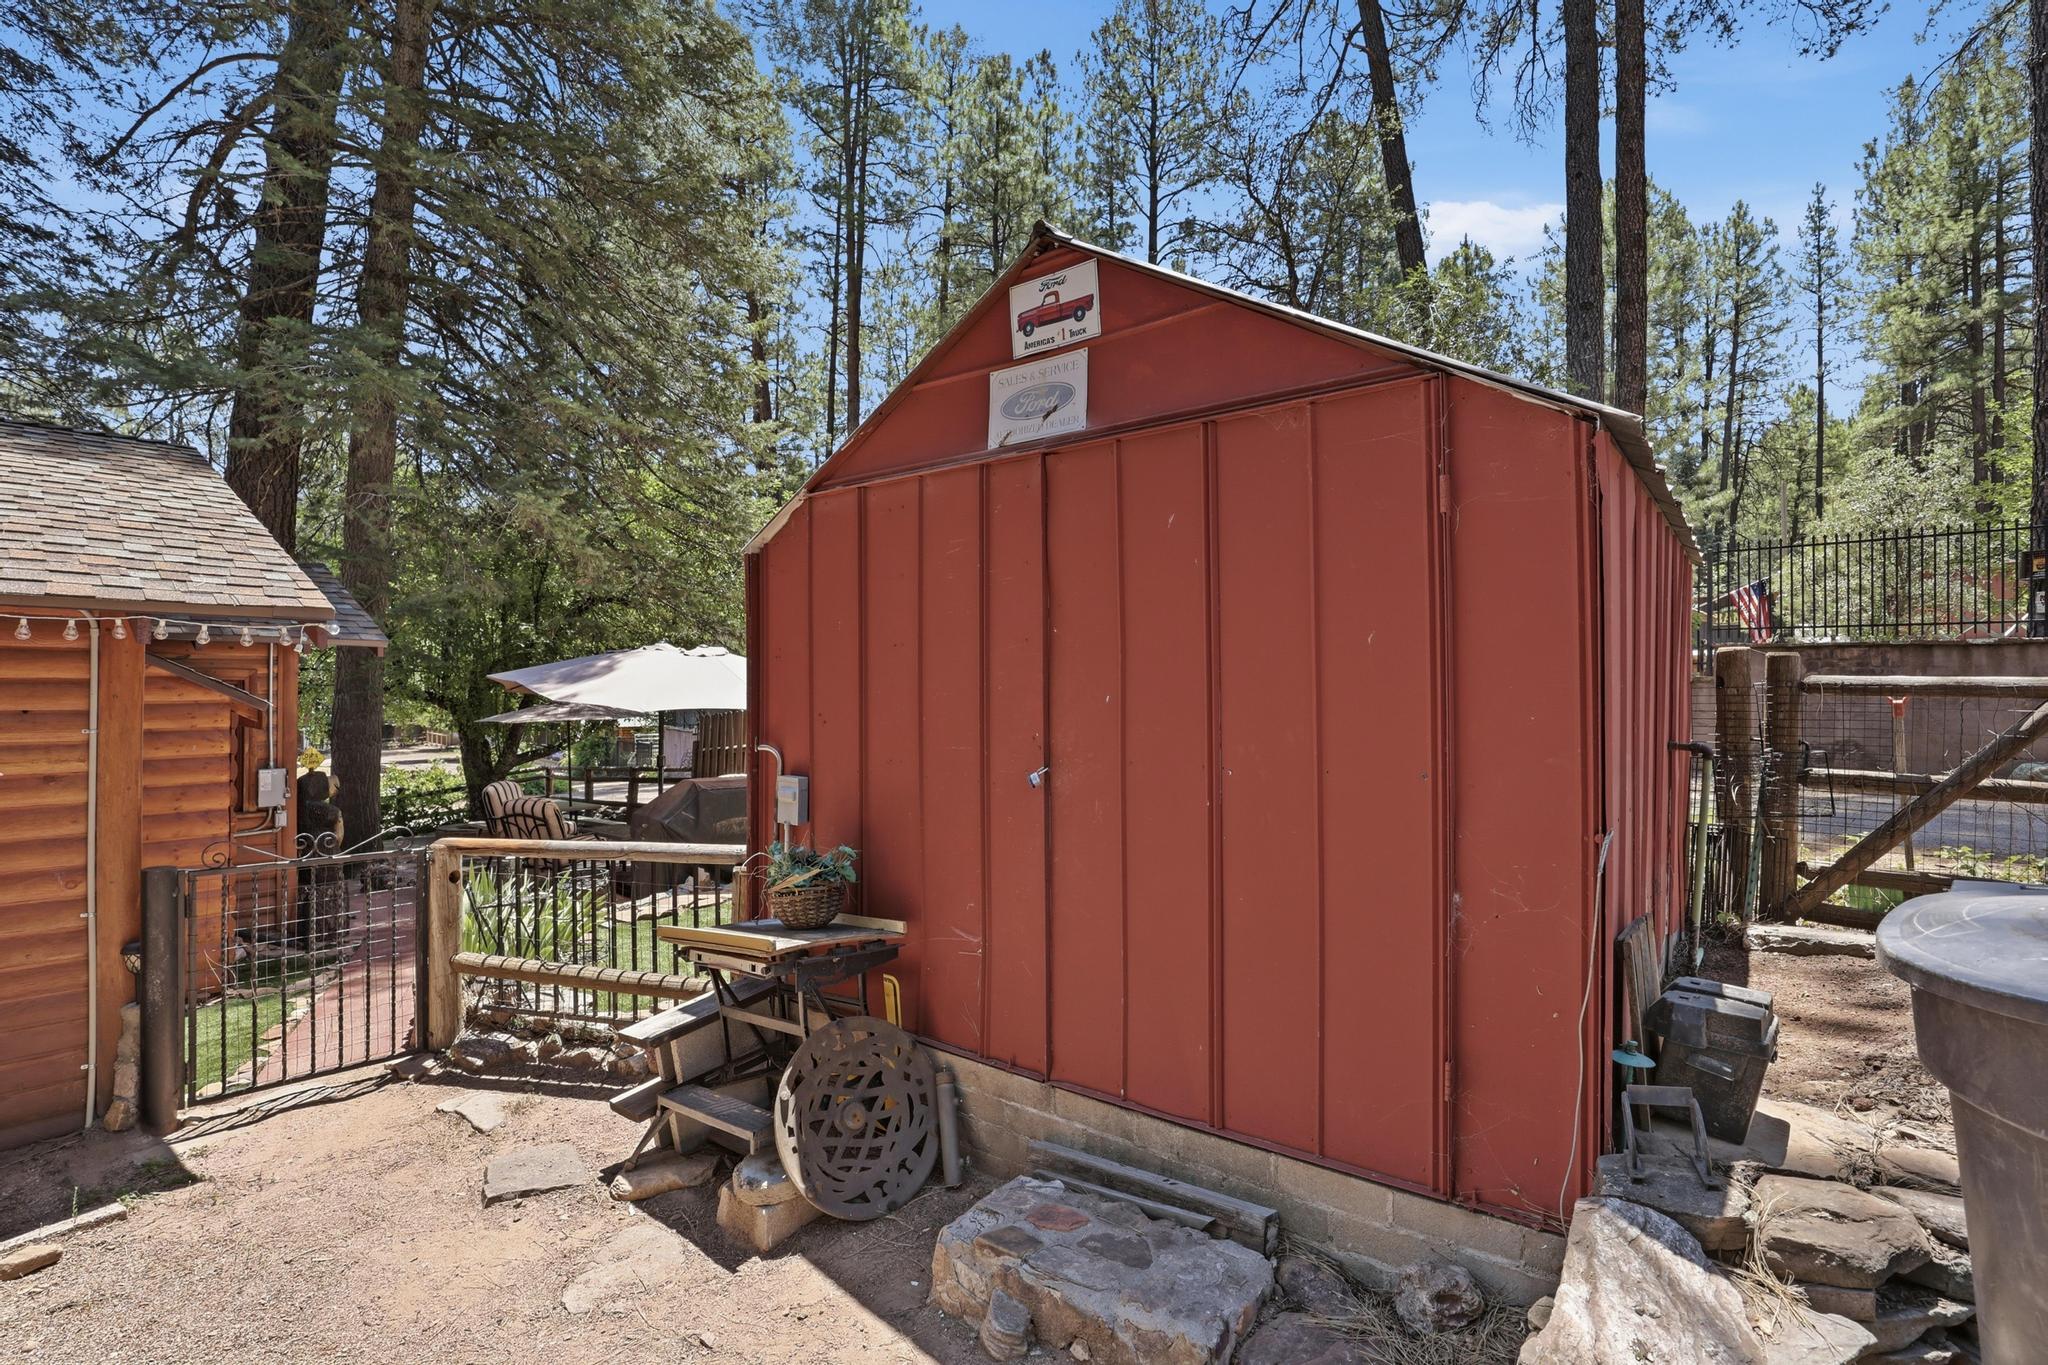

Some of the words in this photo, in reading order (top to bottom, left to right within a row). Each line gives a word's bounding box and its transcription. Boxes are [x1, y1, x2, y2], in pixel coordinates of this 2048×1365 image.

[1039, 275, 1067, 292] Ford
[1024, 336, 1055, 350] AMERICA'S
[1068, 327, 1087, 338] TRUCK
[998, 373, 1027, 386] SALES
[1038, 359, 1080, 378] SERVICE
[1014, 390, 1060, 414] Ford
